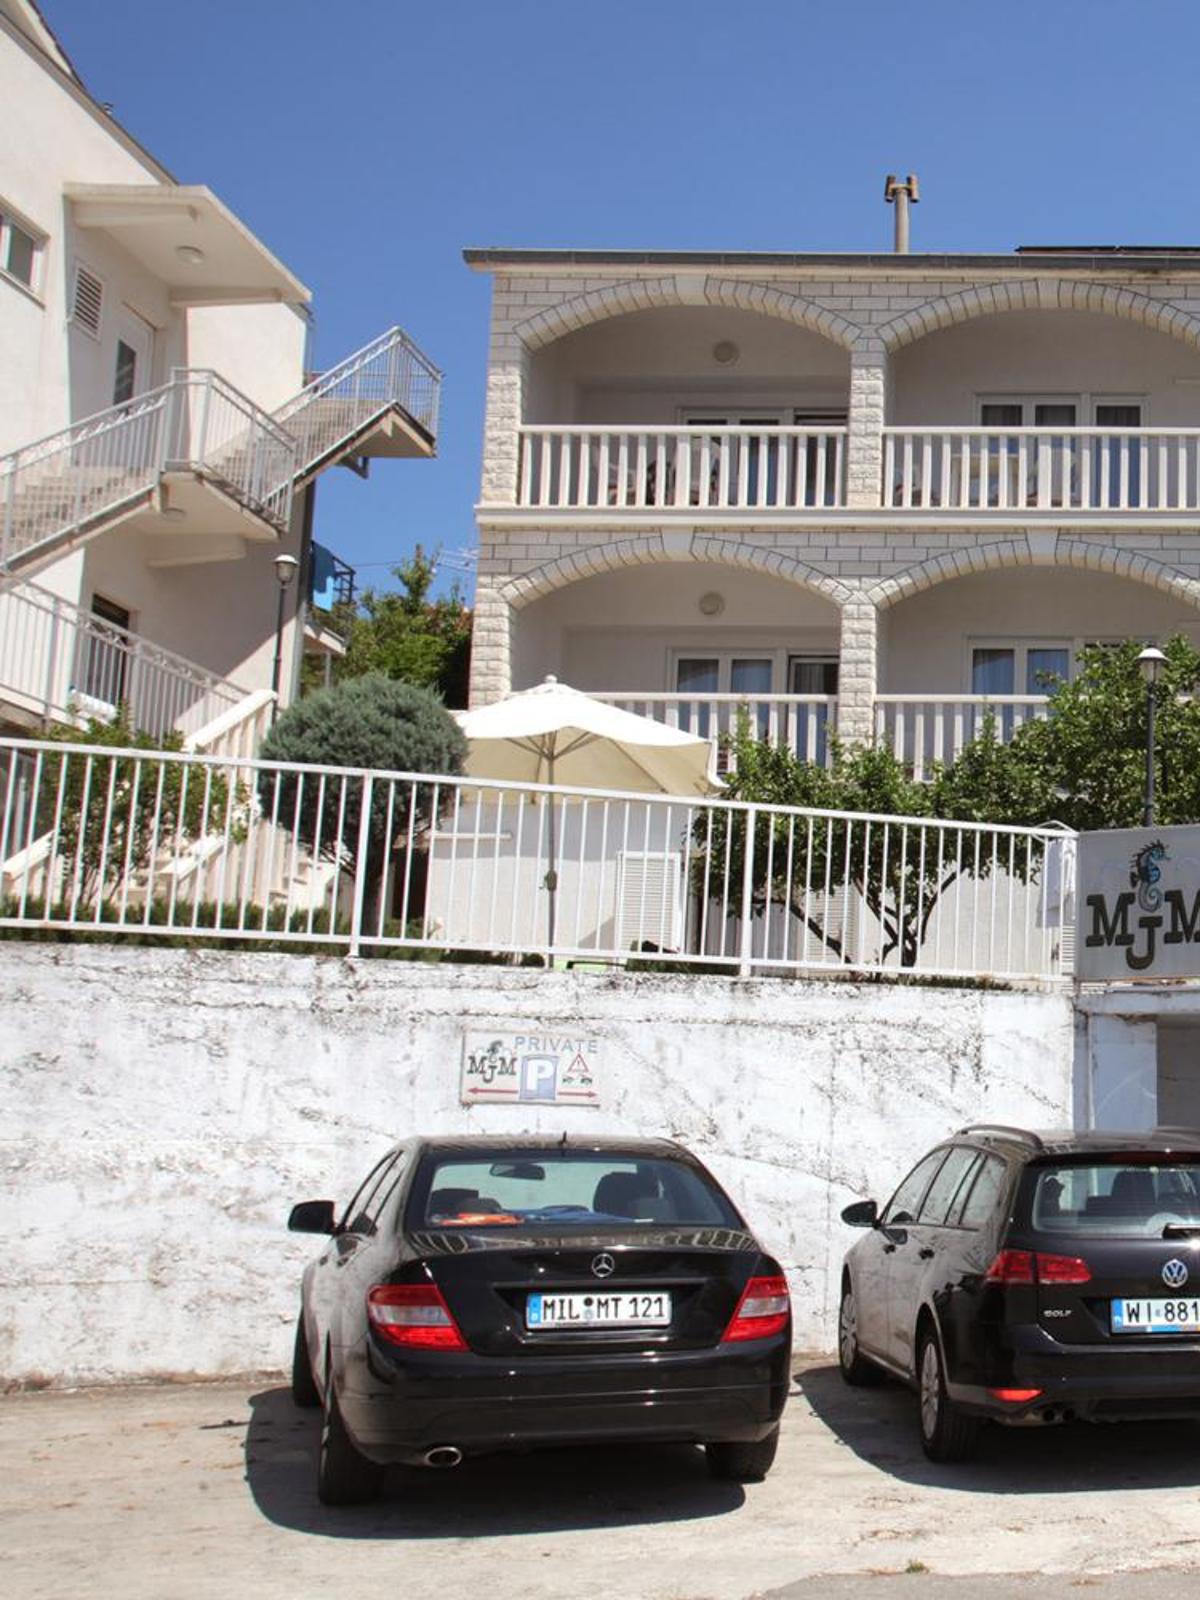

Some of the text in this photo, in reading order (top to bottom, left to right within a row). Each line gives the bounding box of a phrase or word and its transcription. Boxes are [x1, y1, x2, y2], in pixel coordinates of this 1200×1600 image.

[514, 1036, 598, 1054] PRIVATE
[526, 1060, 554, 1091] P
[543, 1298, 580, 1320] MIL
[596, 1297, 622, 1318] MT
[629, 1297, 664, 1318] 121
[1126, 1302, 1152, 1322] WI
